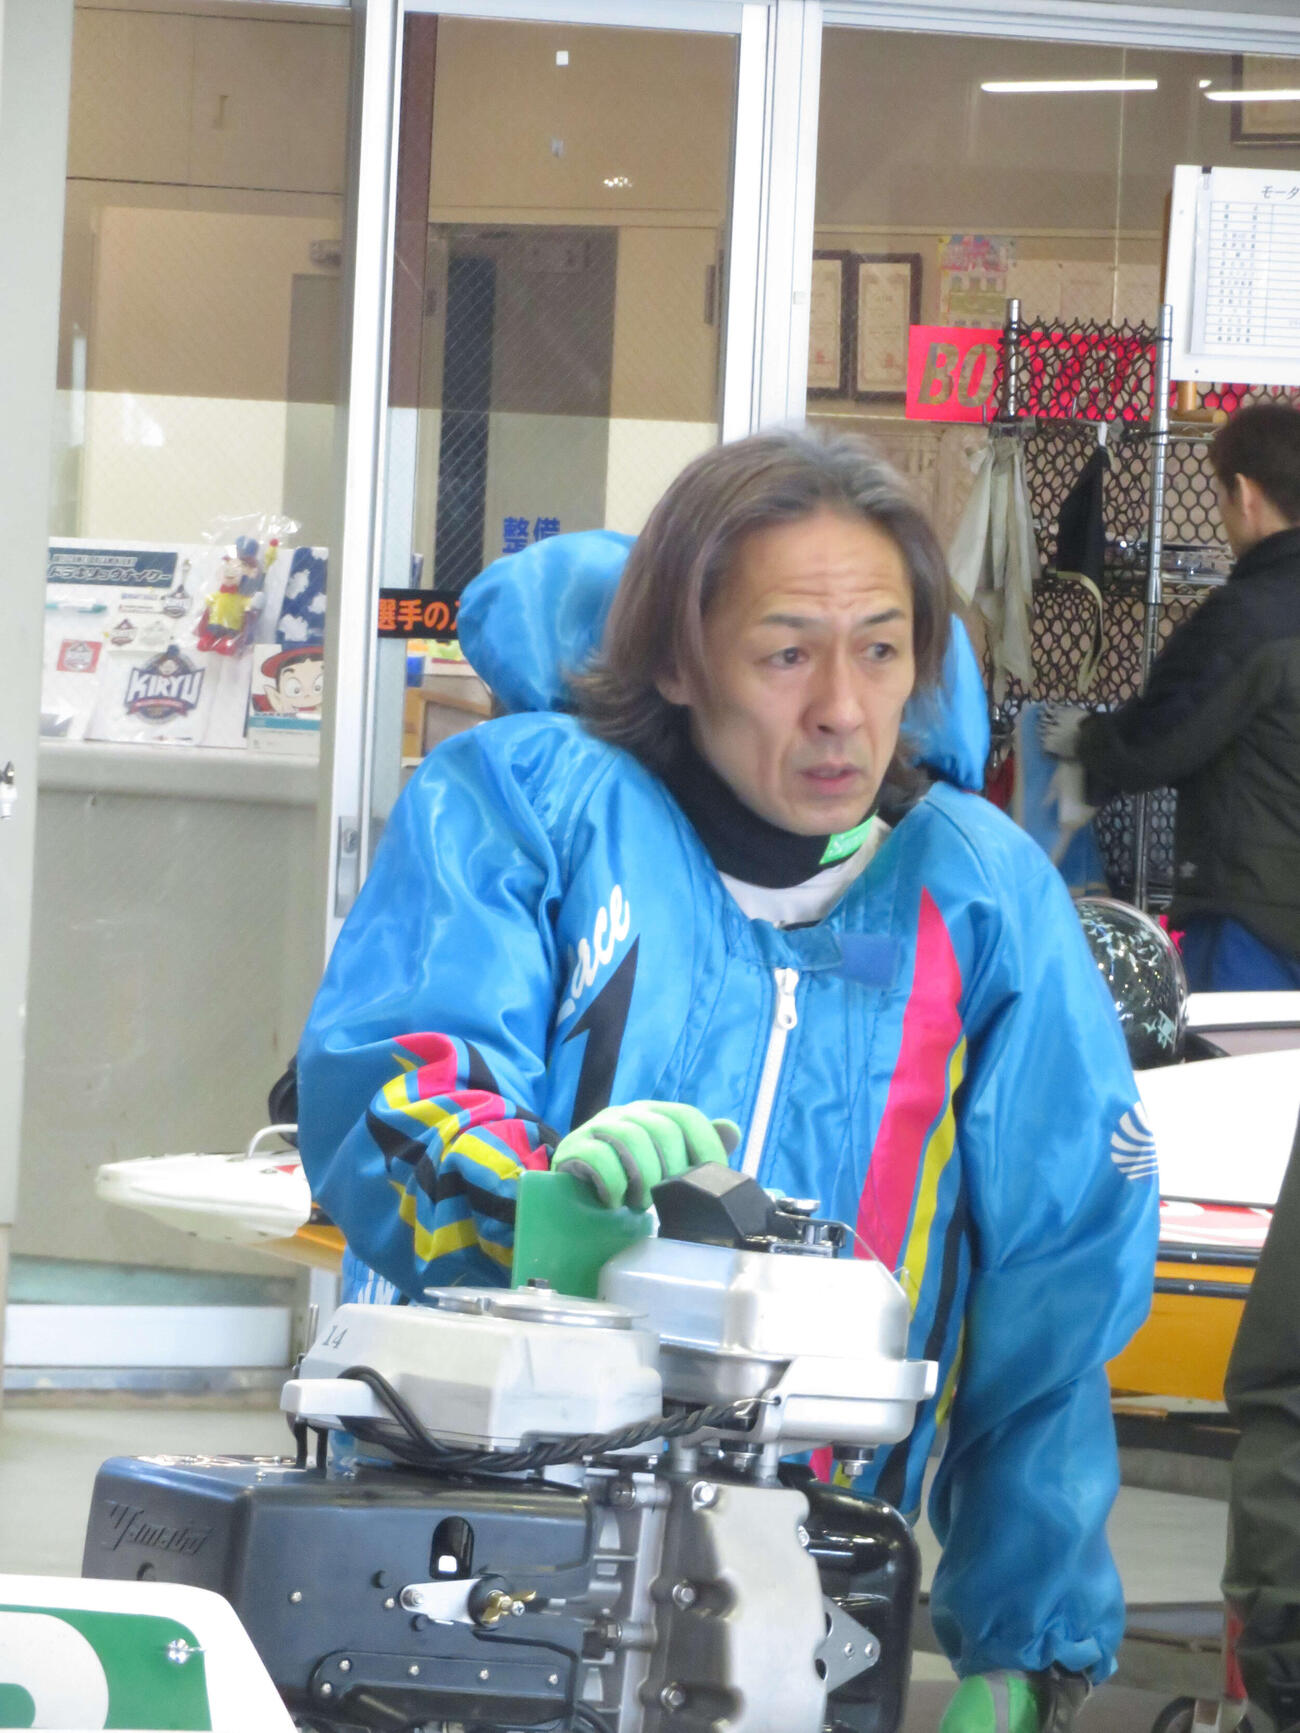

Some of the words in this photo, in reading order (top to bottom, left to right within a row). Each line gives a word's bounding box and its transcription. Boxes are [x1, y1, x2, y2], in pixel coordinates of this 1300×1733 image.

[378, 598, 461, 632] 選手の
[126, 667, 203, 705] KIRYU
[322, 1325, 348, 1349] 14
